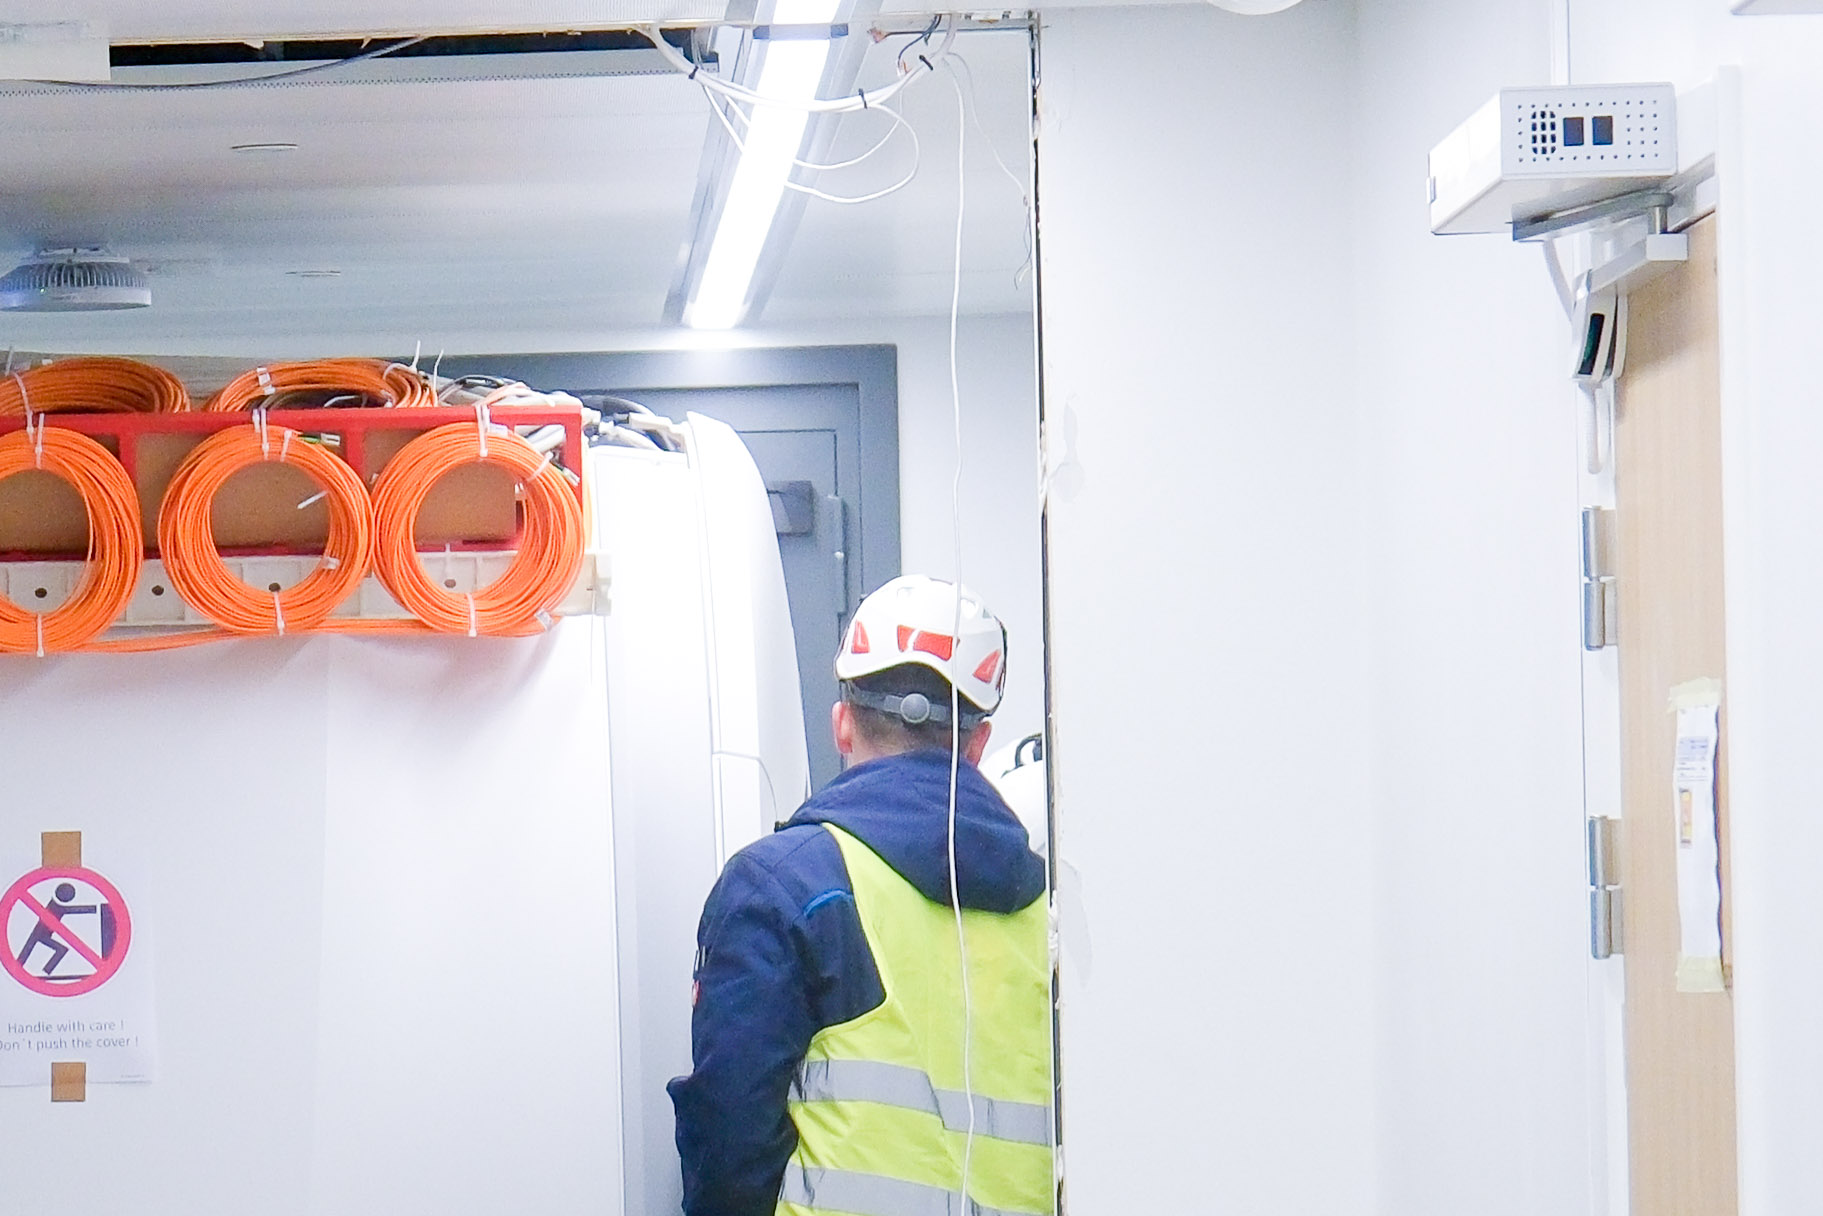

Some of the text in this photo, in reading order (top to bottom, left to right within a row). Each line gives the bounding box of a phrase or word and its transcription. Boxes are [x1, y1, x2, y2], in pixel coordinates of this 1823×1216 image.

[7, 1021, 53, 1034] Handle
[57, 1020, 85, 1033] with
[89, 1021, 116, 1032] care
[36, 1038, 67, 1052] push
[71, 1037, 93, 1049] the
[96, 1037, 131, 1048] cover
